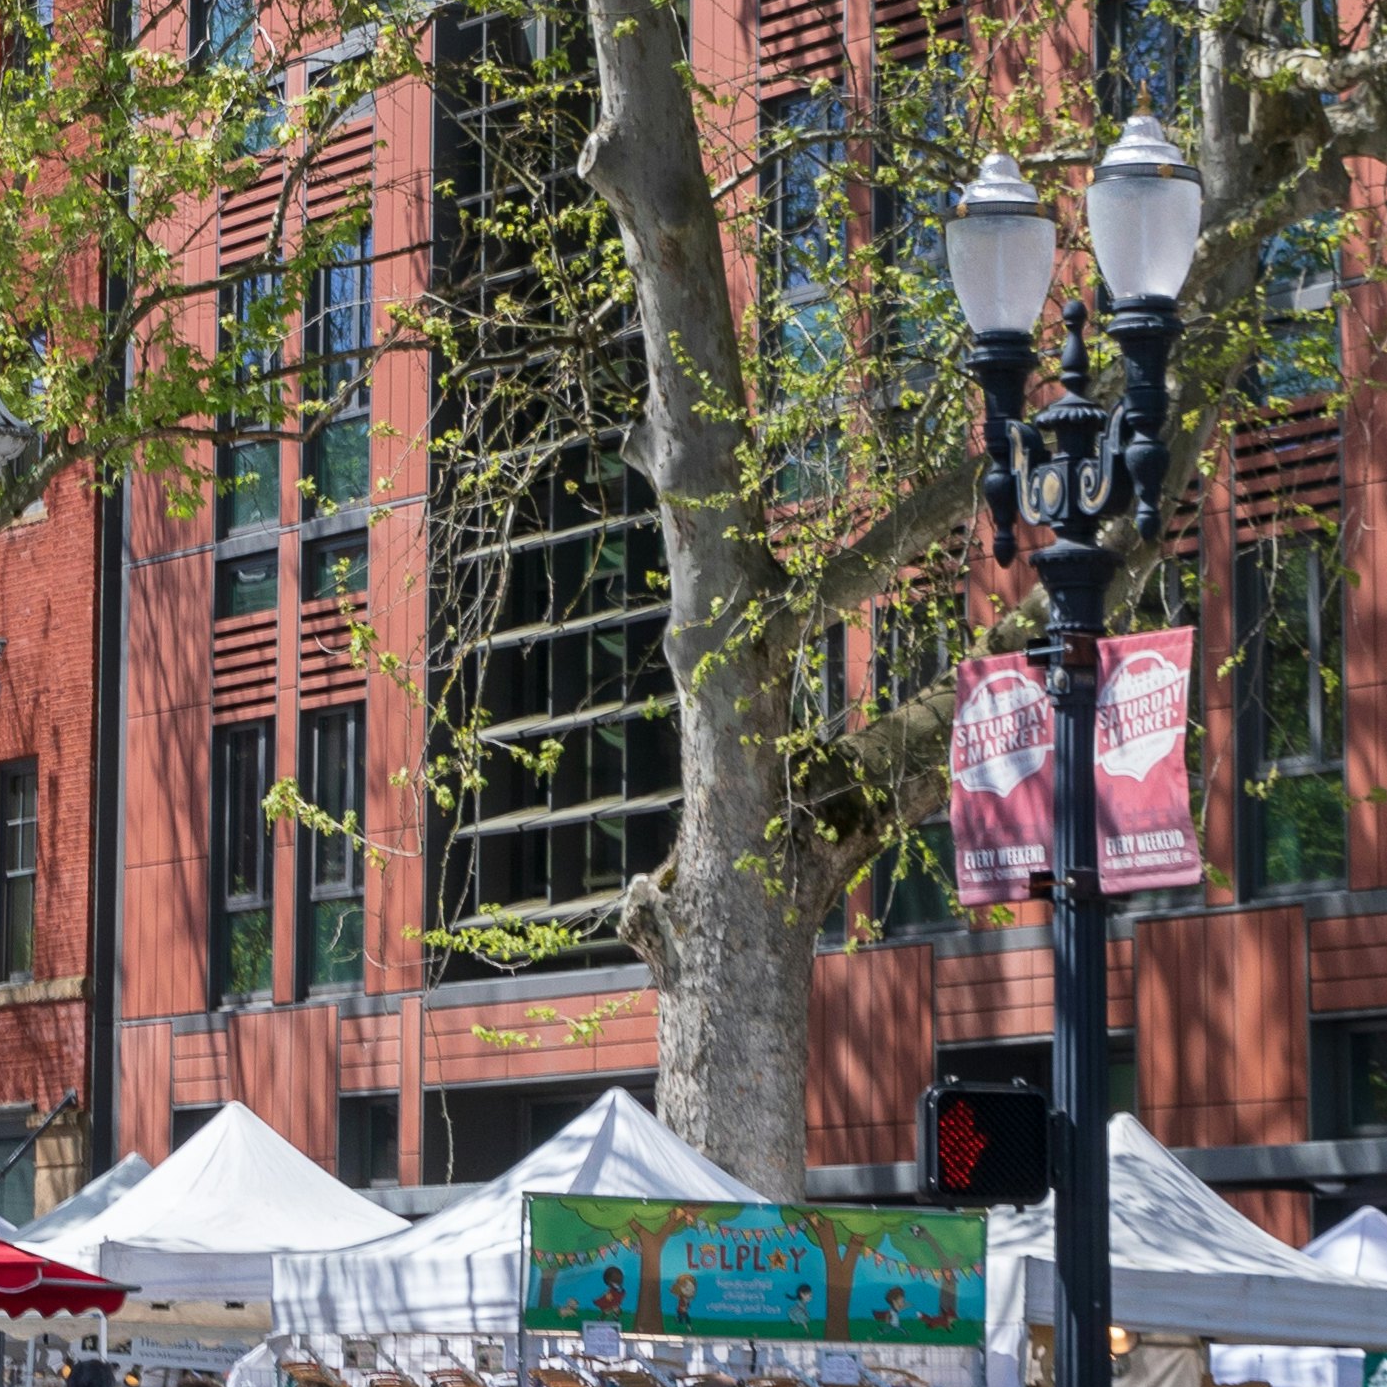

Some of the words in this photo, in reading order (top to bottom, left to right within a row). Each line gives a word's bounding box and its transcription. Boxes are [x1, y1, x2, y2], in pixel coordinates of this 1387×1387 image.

[956, 697, 1050, 748] SATURDAY
[1097, 680, 1183, 730] SATURDAY
[967, 724, 1040, 766] MARKET
[1109, 707, 1173, 748] MARKET
[964, 849, 995, 870] EVERY
[997, 844, 1045, 867] WEEKEND
[1105, 835, 1134, 856] EVERY
[1136, 829, 1185, 853] WEEKEND
